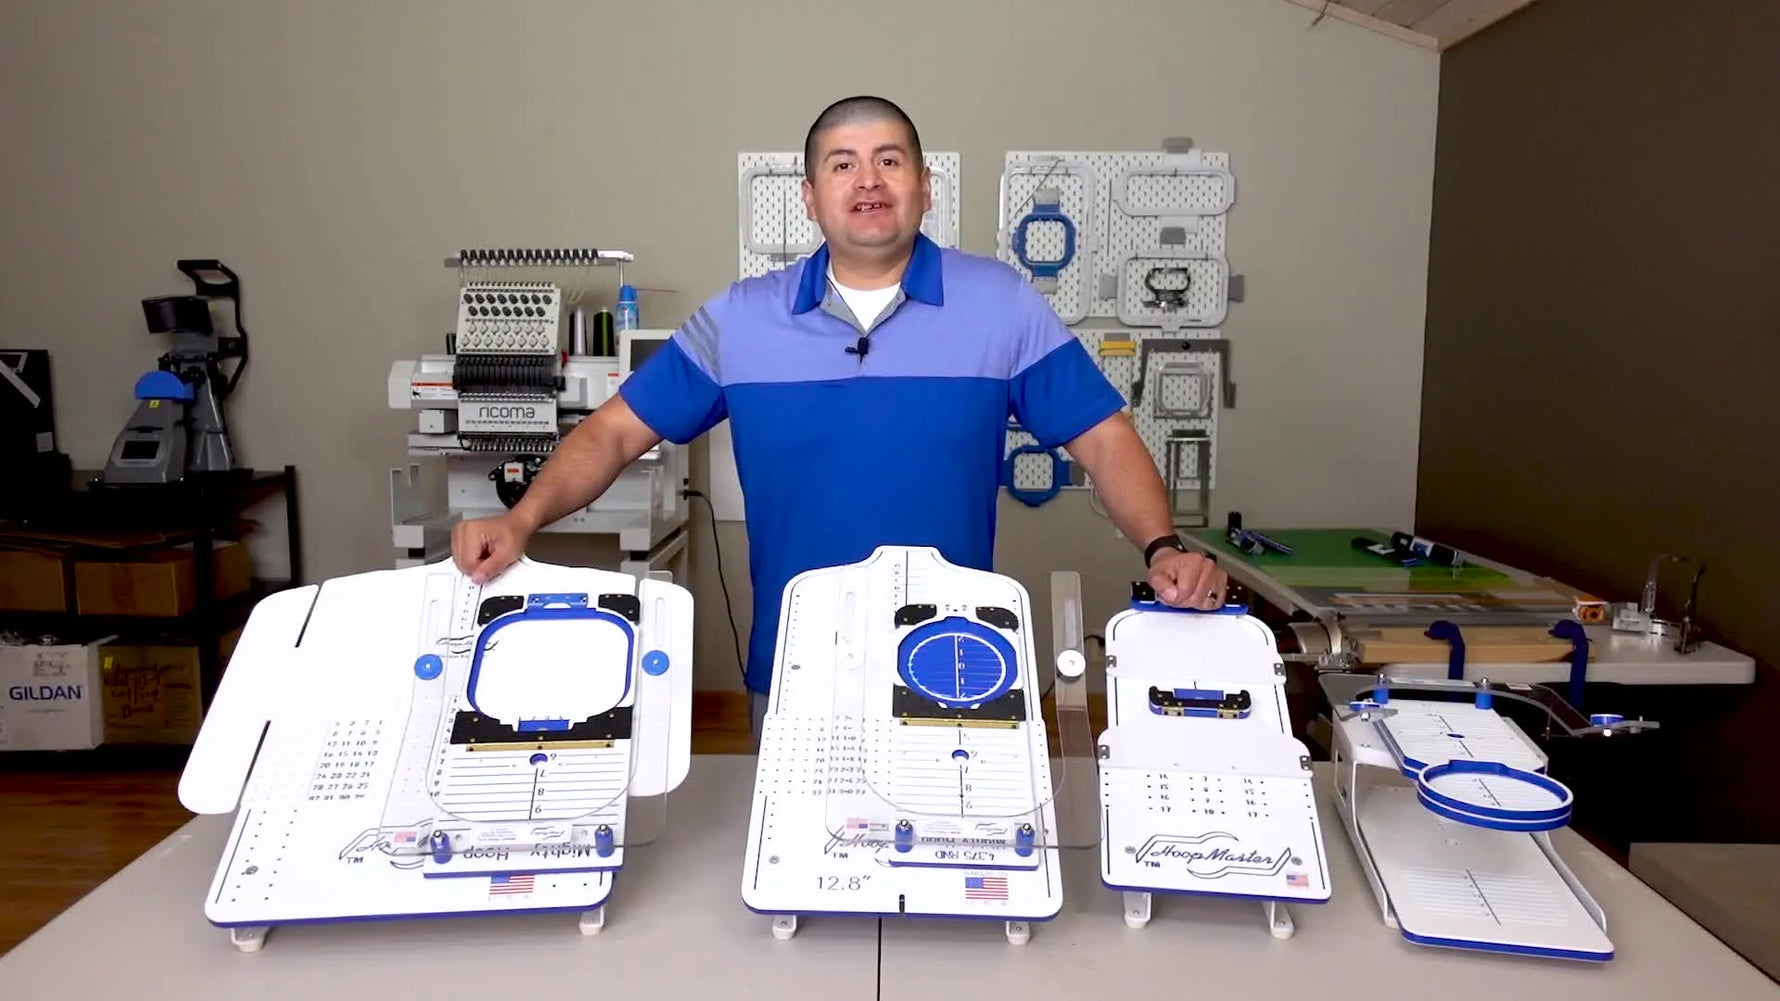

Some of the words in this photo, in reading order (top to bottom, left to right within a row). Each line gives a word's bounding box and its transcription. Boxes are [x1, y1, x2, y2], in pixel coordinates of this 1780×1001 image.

[479, 406, 535, 418] ricoma
[9, 686, 81, 700] GILDAN
[538, 788, 544, 796] 8
[535, 805, 542, 813] 9
[464, 846, 510, 860] Hoop
[530, 843, 591, 859] Mighty
